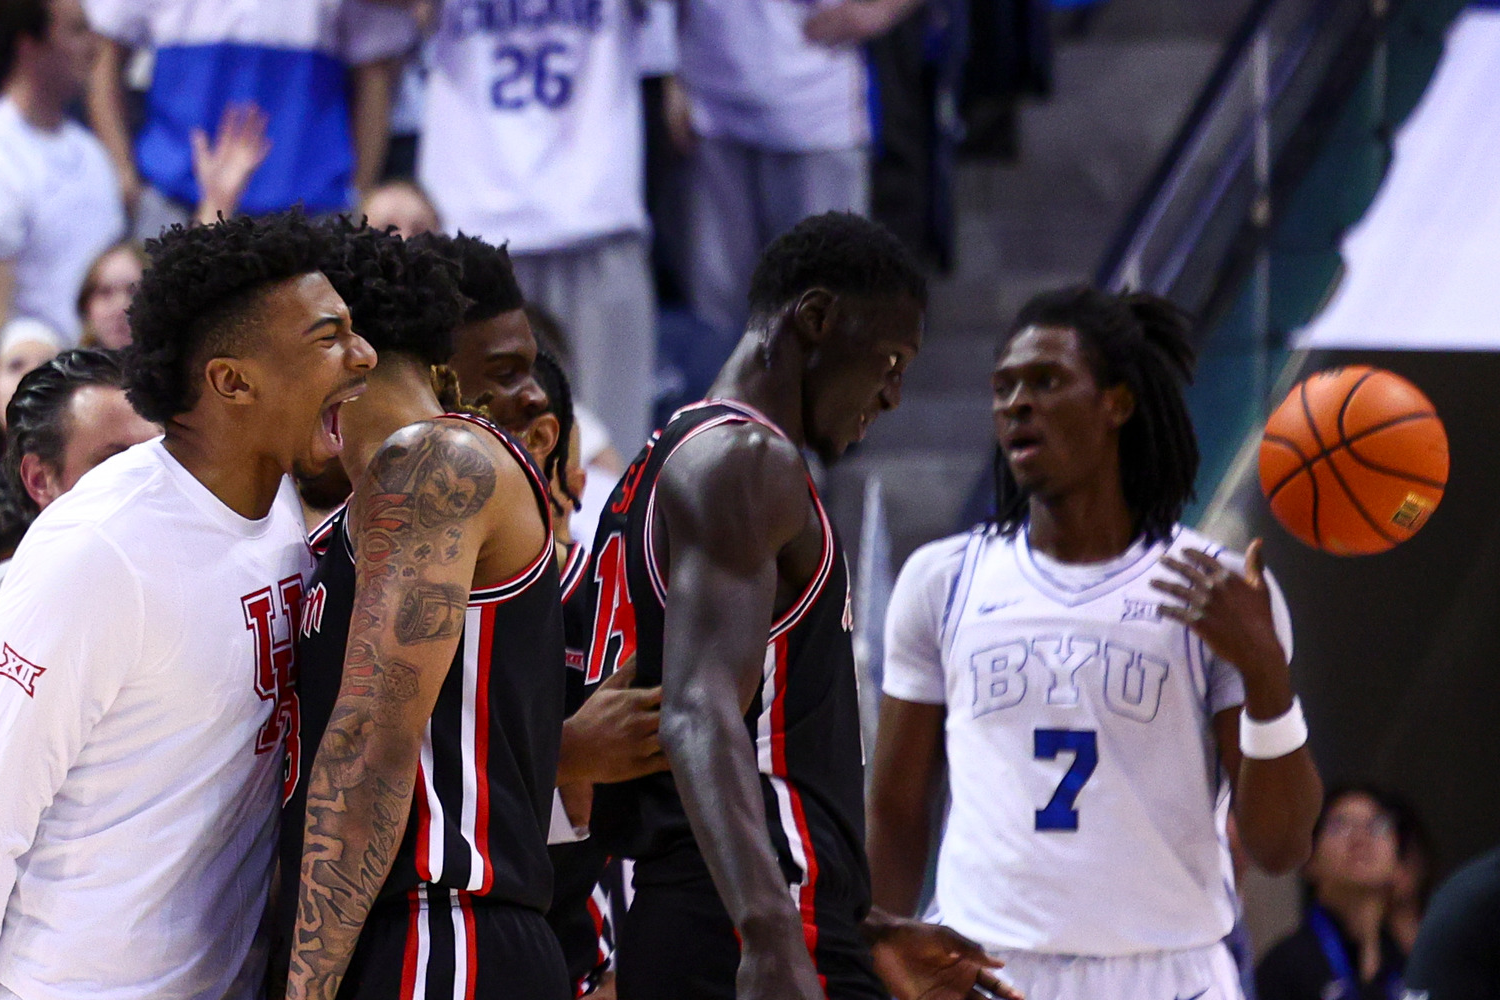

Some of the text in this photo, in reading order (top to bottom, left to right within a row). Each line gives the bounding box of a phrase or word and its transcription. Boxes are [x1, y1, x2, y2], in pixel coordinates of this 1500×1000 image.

[490, 40, 573, 110] 26
[970, 635, 1170, 724] BYU
[1033, 727, 1099, 833] 7
